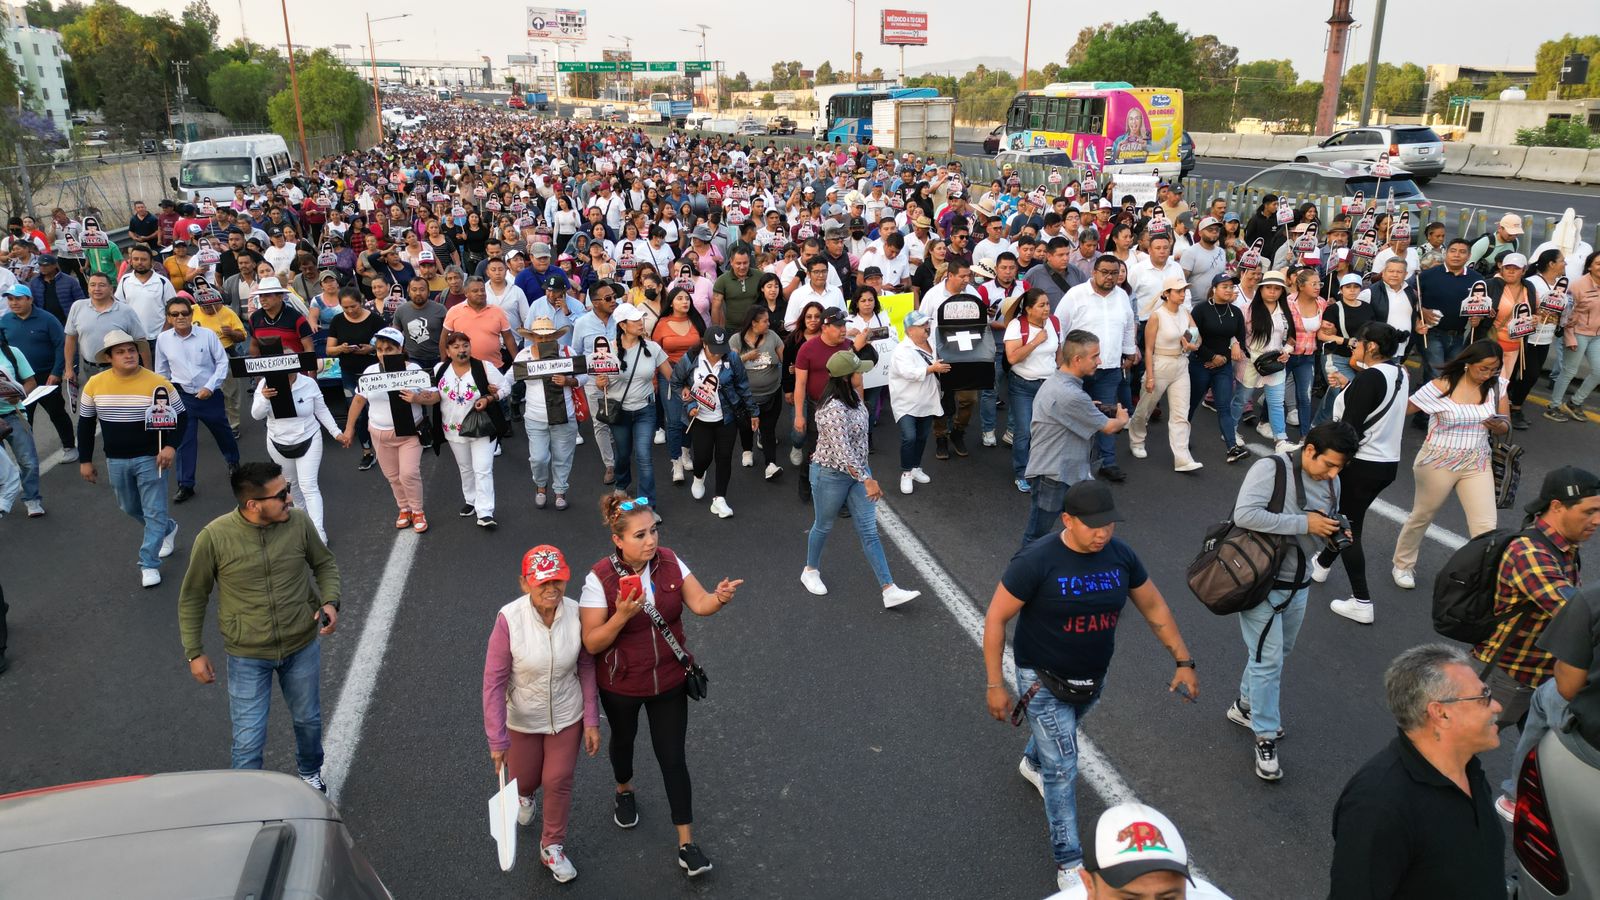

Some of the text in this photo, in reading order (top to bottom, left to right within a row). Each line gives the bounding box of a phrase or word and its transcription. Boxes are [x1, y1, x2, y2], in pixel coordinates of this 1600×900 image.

[1120, 143, 1142, 151] GANA
[245, 361, 254, 371] NO
[527, 365, 536, 374] NO
[1057, 568, 1121, 596] TOMMY
[1063, 611, 1119, 633] JEANS
